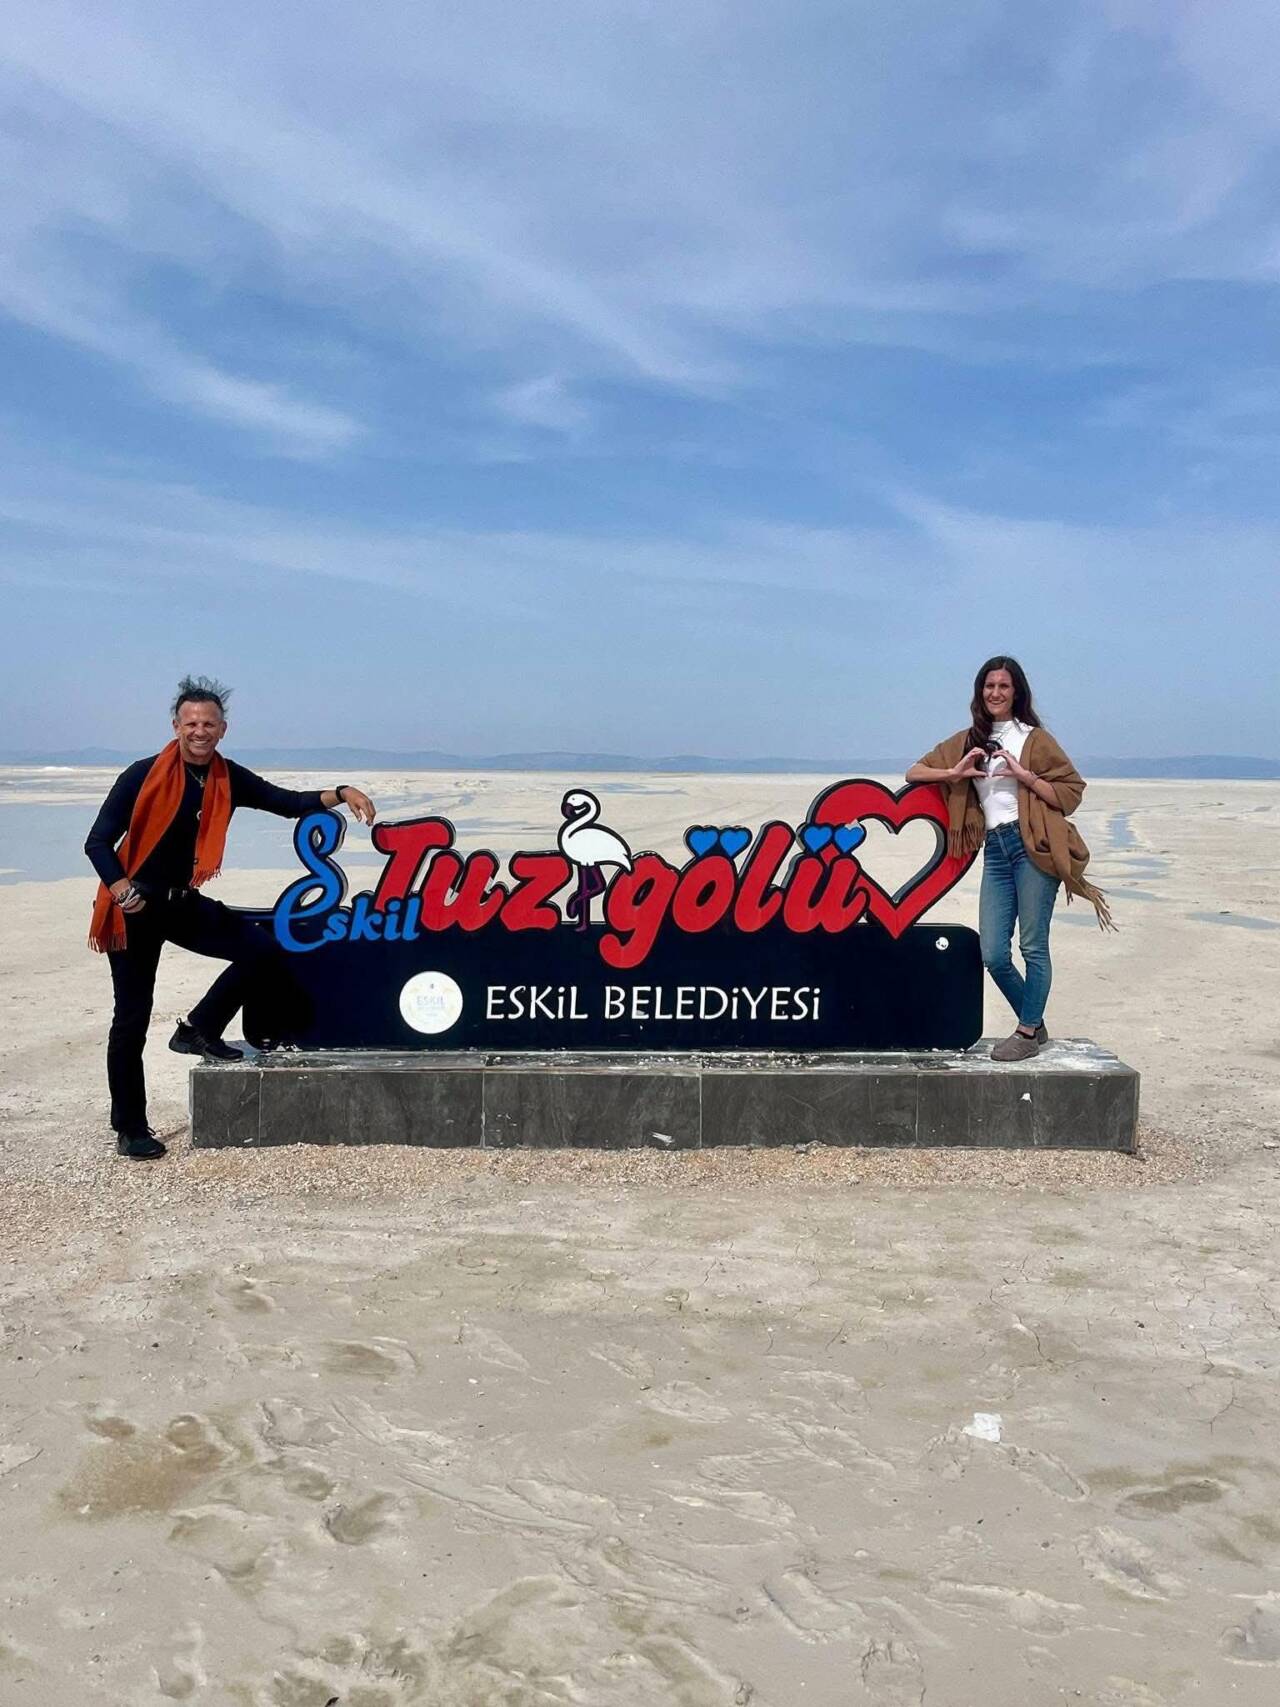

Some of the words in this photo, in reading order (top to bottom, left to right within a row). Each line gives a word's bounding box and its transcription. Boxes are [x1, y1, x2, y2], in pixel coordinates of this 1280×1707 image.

[273, 812, 420, 952] Eskil
[374, 820, 572, 932] Tuz
[599, 823, 870, 969] gölü
